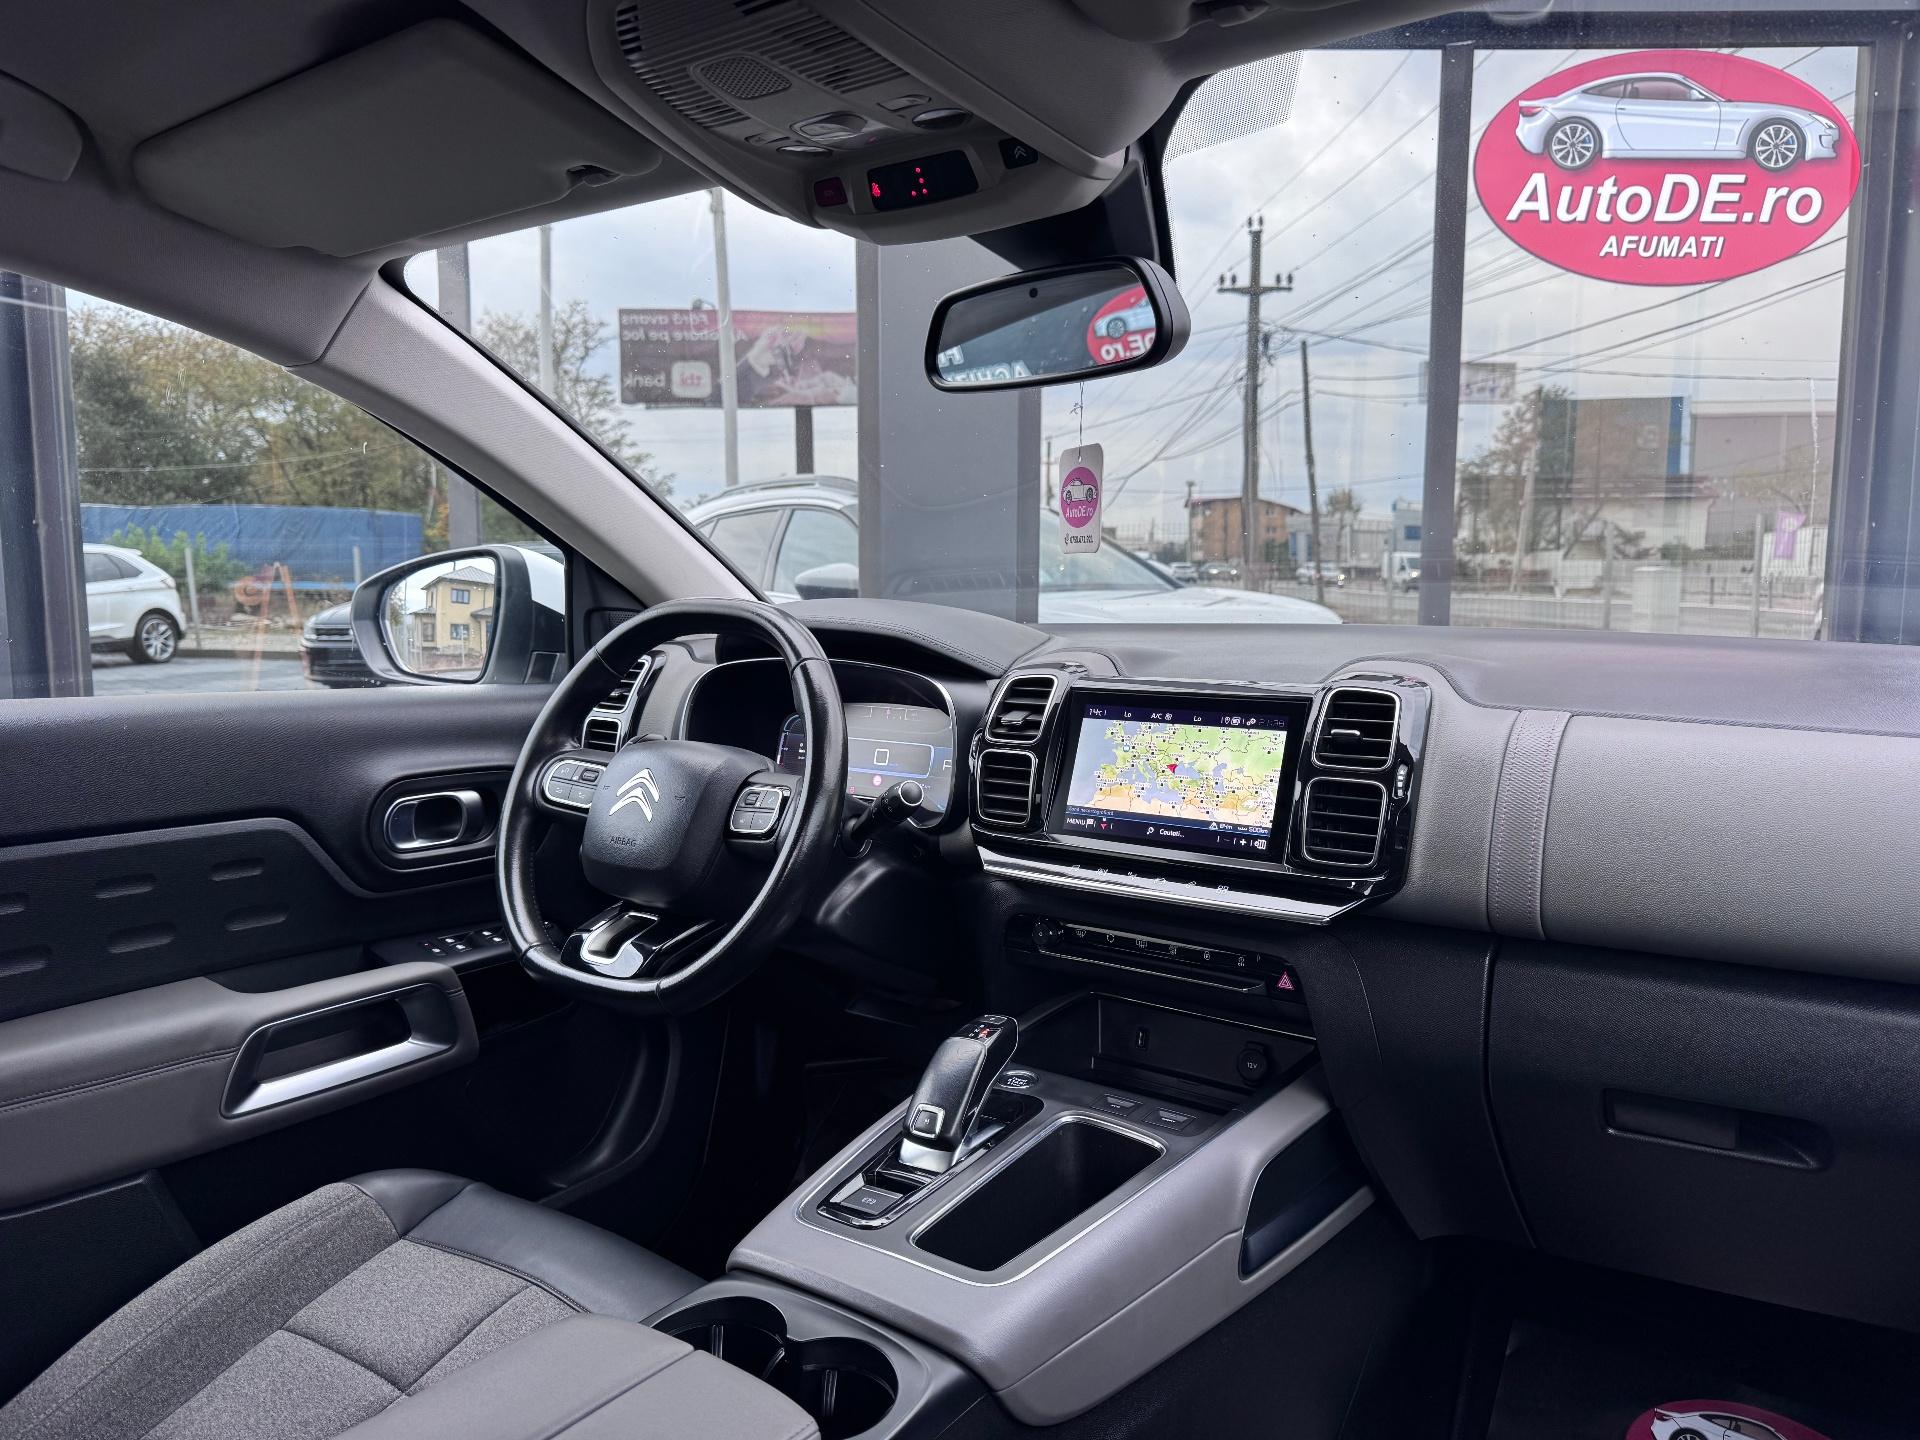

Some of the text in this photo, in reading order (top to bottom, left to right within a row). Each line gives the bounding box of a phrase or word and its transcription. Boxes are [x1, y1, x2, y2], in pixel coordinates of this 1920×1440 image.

[1505, 172, 1825, 225] AutoDE.ro
[1599, 235, 1726, 259] AFUMATI
[609, 836, 637, 847] AIRBAG
